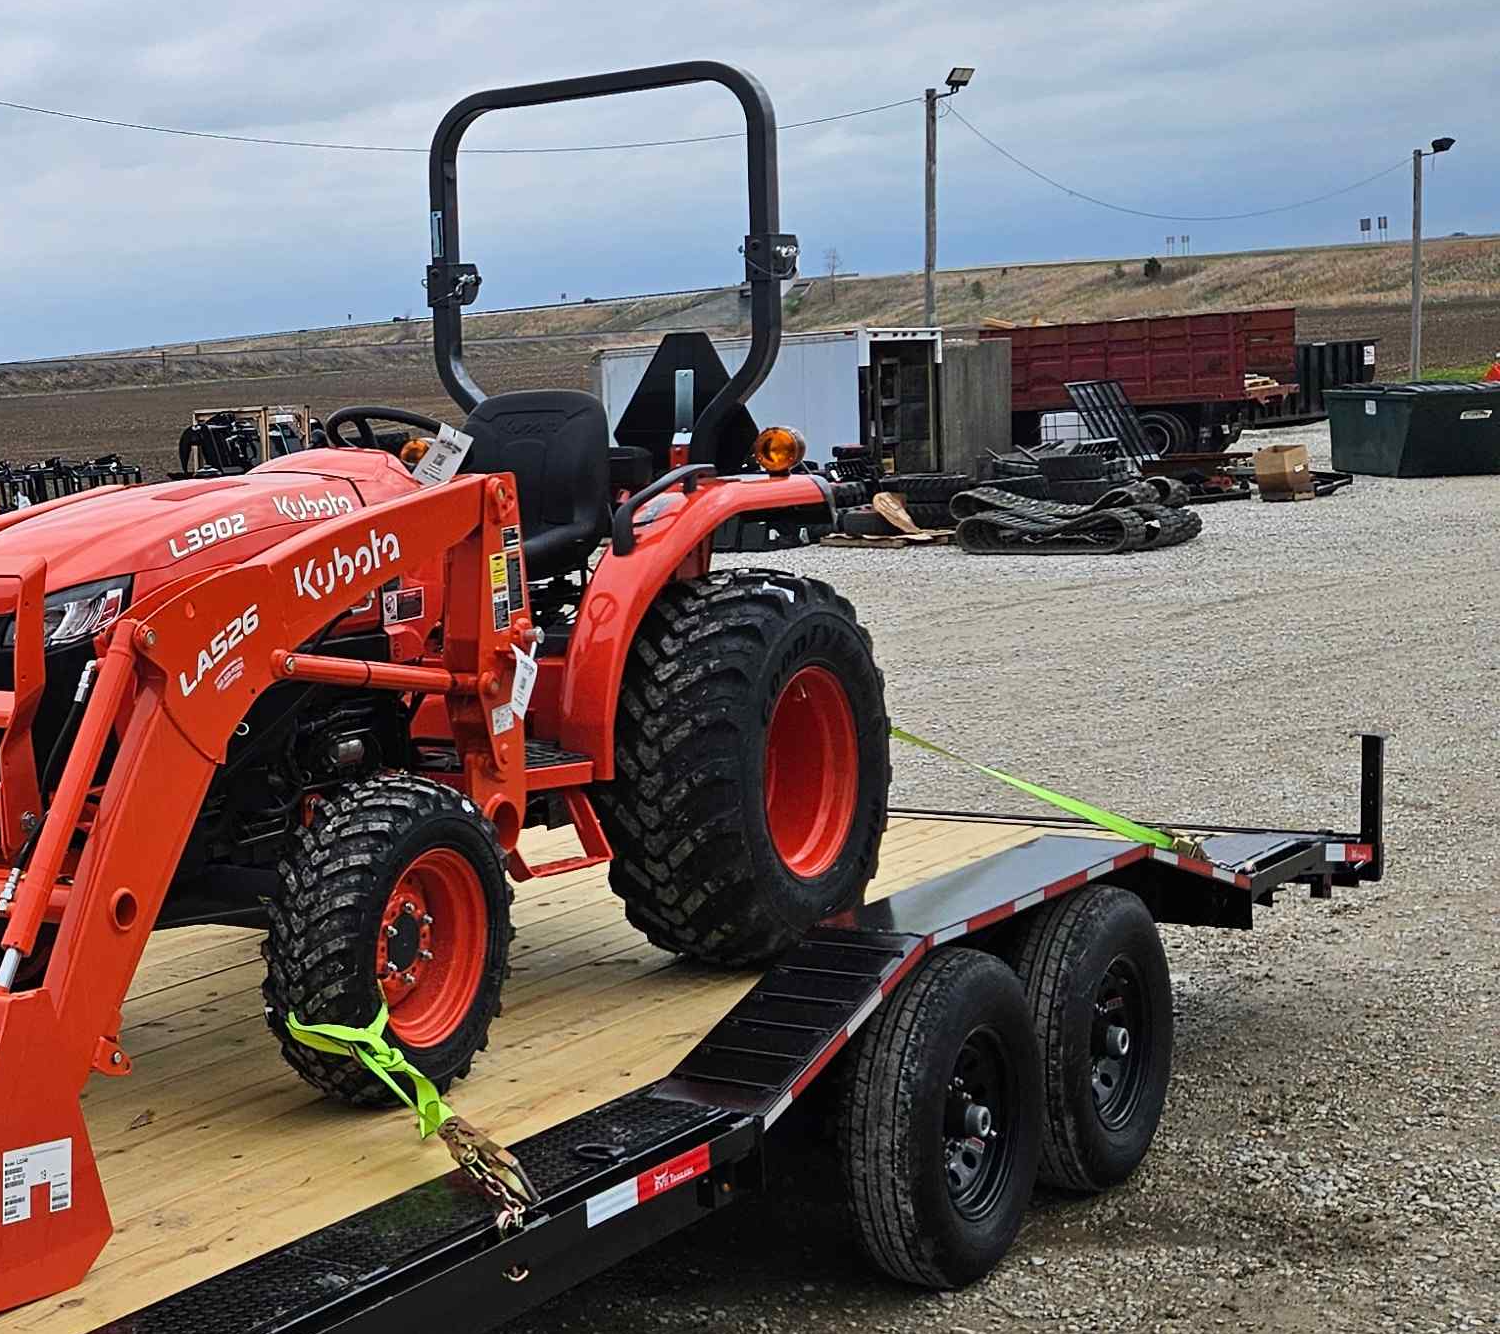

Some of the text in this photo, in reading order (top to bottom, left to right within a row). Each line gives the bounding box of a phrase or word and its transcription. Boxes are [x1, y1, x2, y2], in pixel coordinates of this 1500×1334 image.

[272, 491, 353, 522] Kubota
[168, 514, 247, 559] L3902
[293, 529, 400, 600] Kubota
[179, 604, 259, 697] LA526
